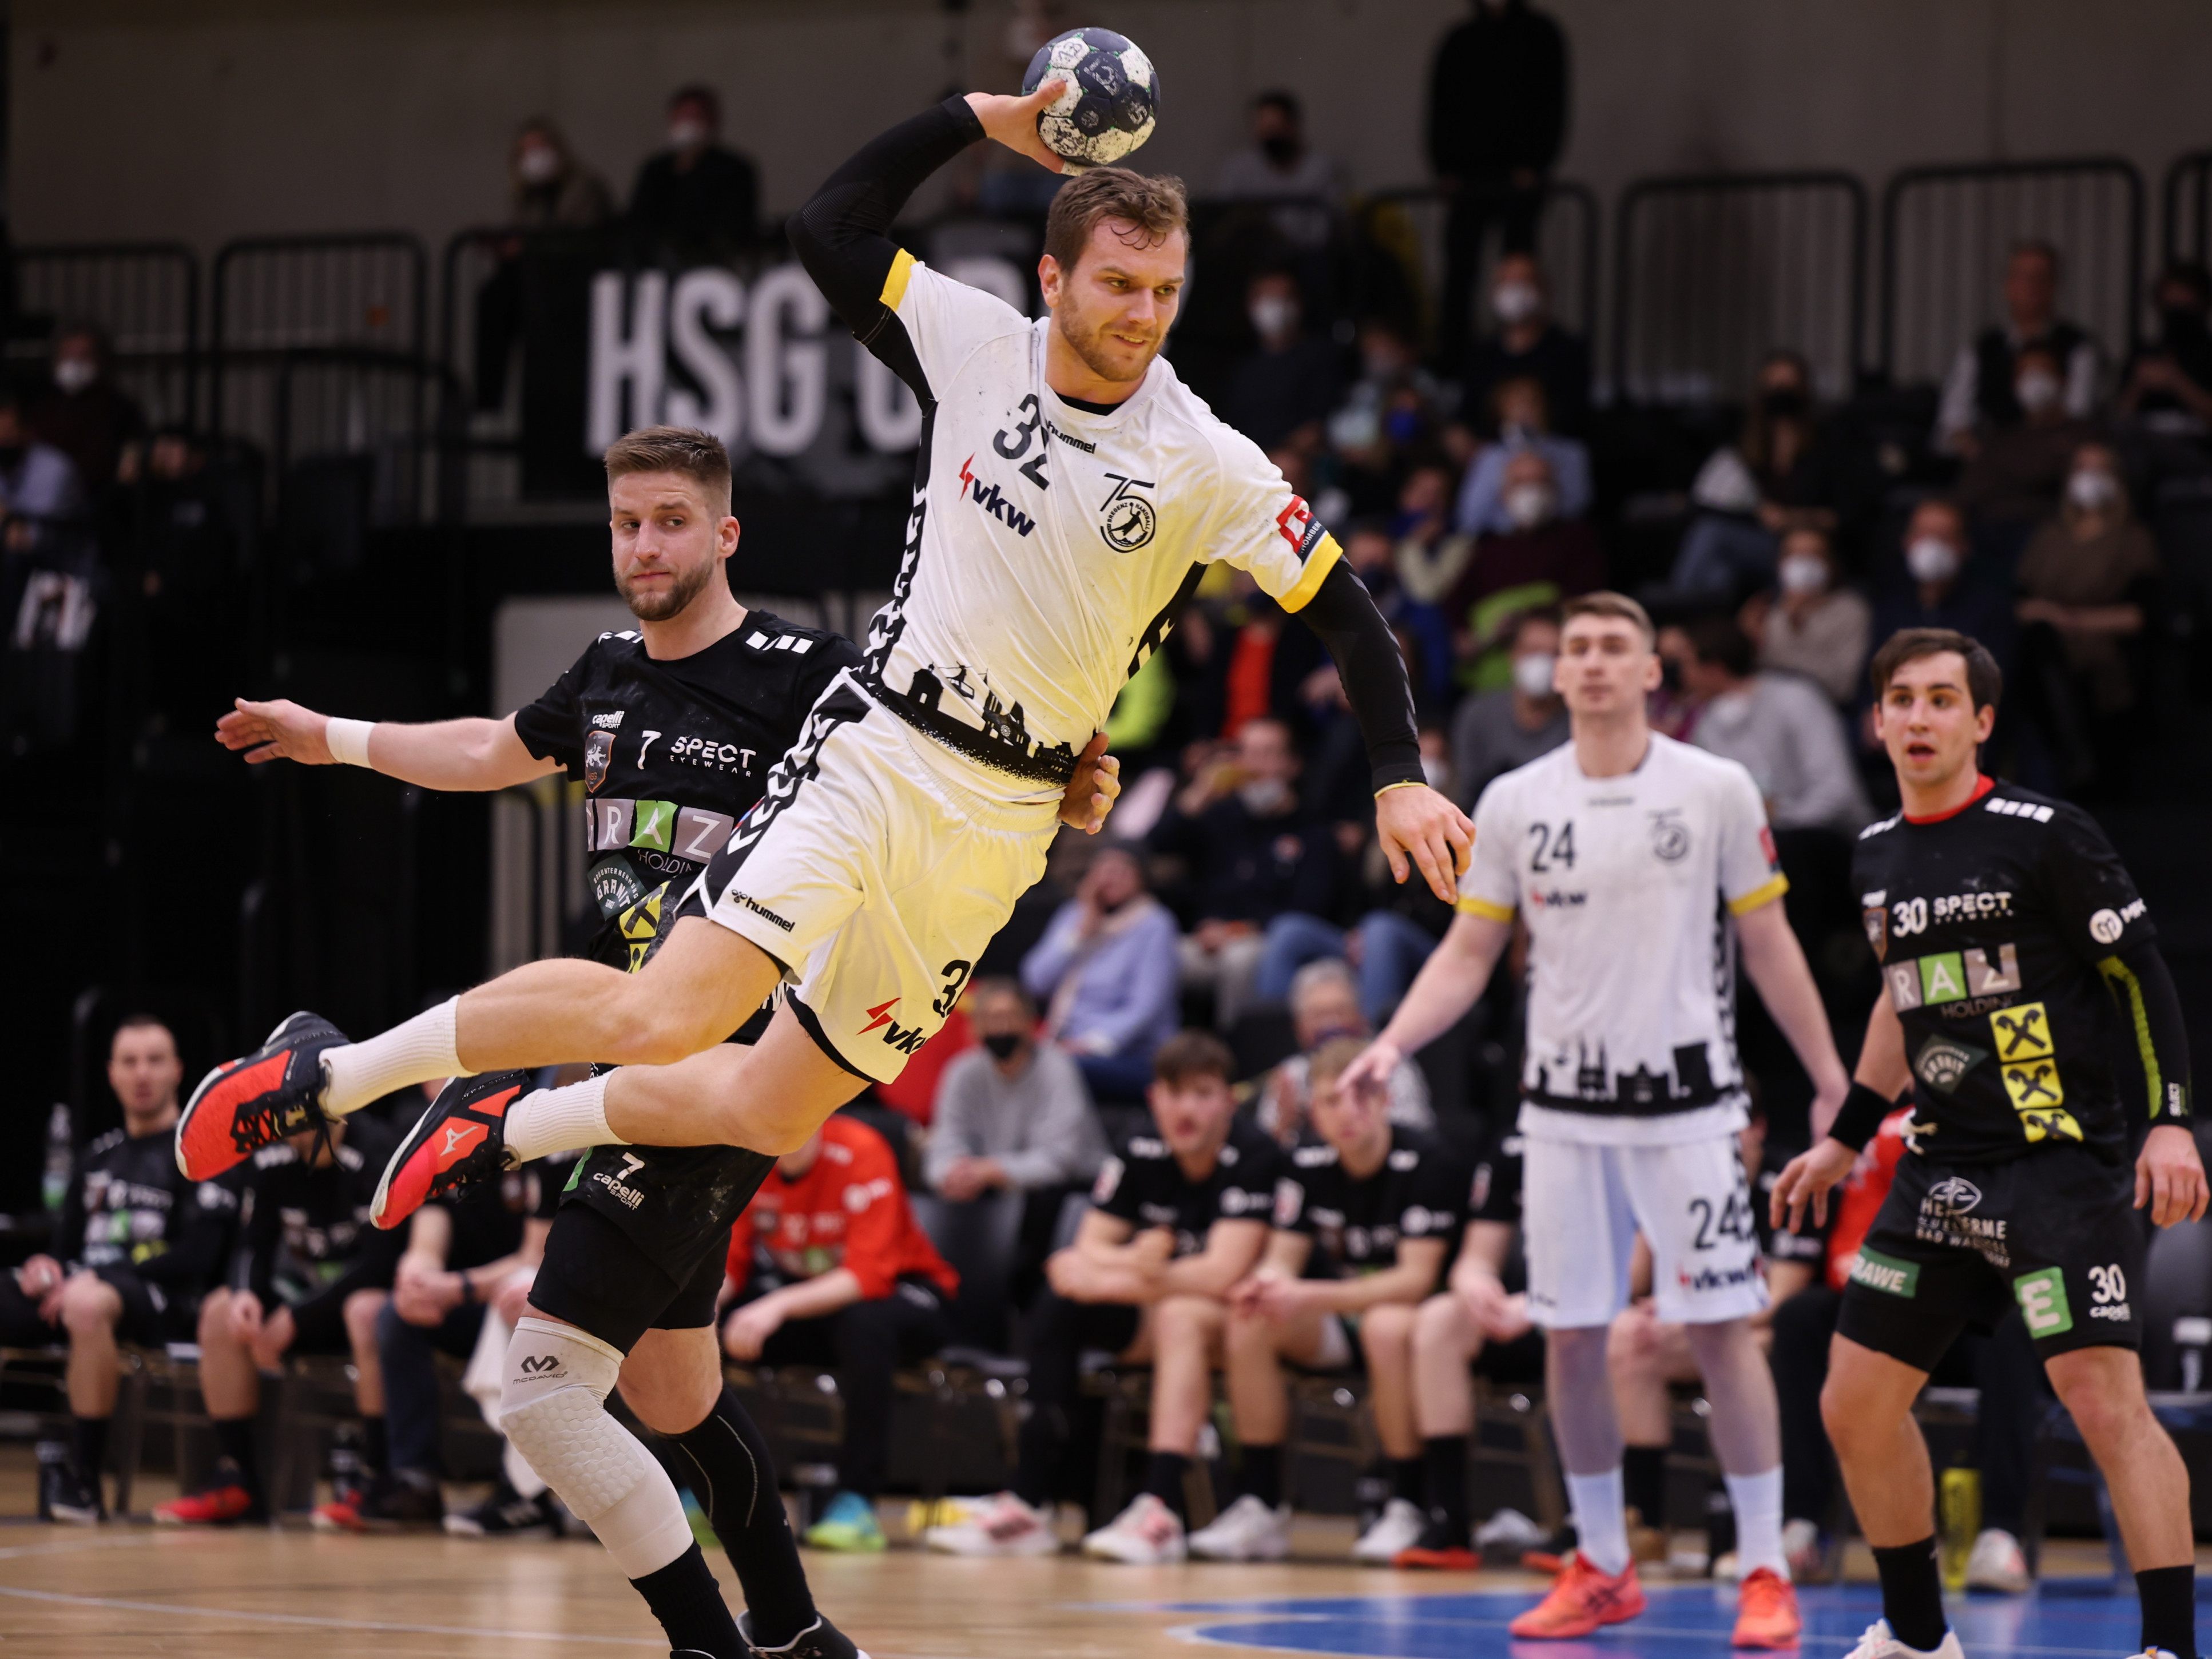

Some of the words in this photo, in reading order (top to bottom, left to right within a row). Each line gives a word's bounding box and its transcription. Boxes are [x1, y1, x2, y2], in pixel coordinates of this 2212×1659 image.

[586, 264, 832, 455] HSG
[993, 394, 1050, 491] 32
[1046, 420, 1096, 454] hummel
[973, 478, 1036, 537] vkw
[1107, 502, 1128, 523] BREGENZ
[1135, 503, 1151, 530] HANDBALL
[592, 711, 625, 727] capelli
[637, 730, 662, 770] 7
[670, 736, 757, 769] SPECT
[670, 755, 752, 777] EYEWEAR
[638, 849, 693, 875] HOLDI
[1528, 819, 1576, 874] 24
[594, 867, 639, 899] BAUUNTERNEHMUNG
[597, 879, 631, 908] GRANIT
[745, 896, 796, 933] hummel
[1892, 896, 1928, 938] 30
[1933, 891, 2012, 916] SPECT
[932, 959, 977, 1018] 3
[883, 1020, 927, 1055] vk
[617, 1152, 645, 1181] 7
[593, 1172, 645, 1207] capelli
[609, 1189, 638, 1211] SPORT
[1688, 1193, 1741, 1251] 24
[2088, 1263, 2126, 1304] 30
